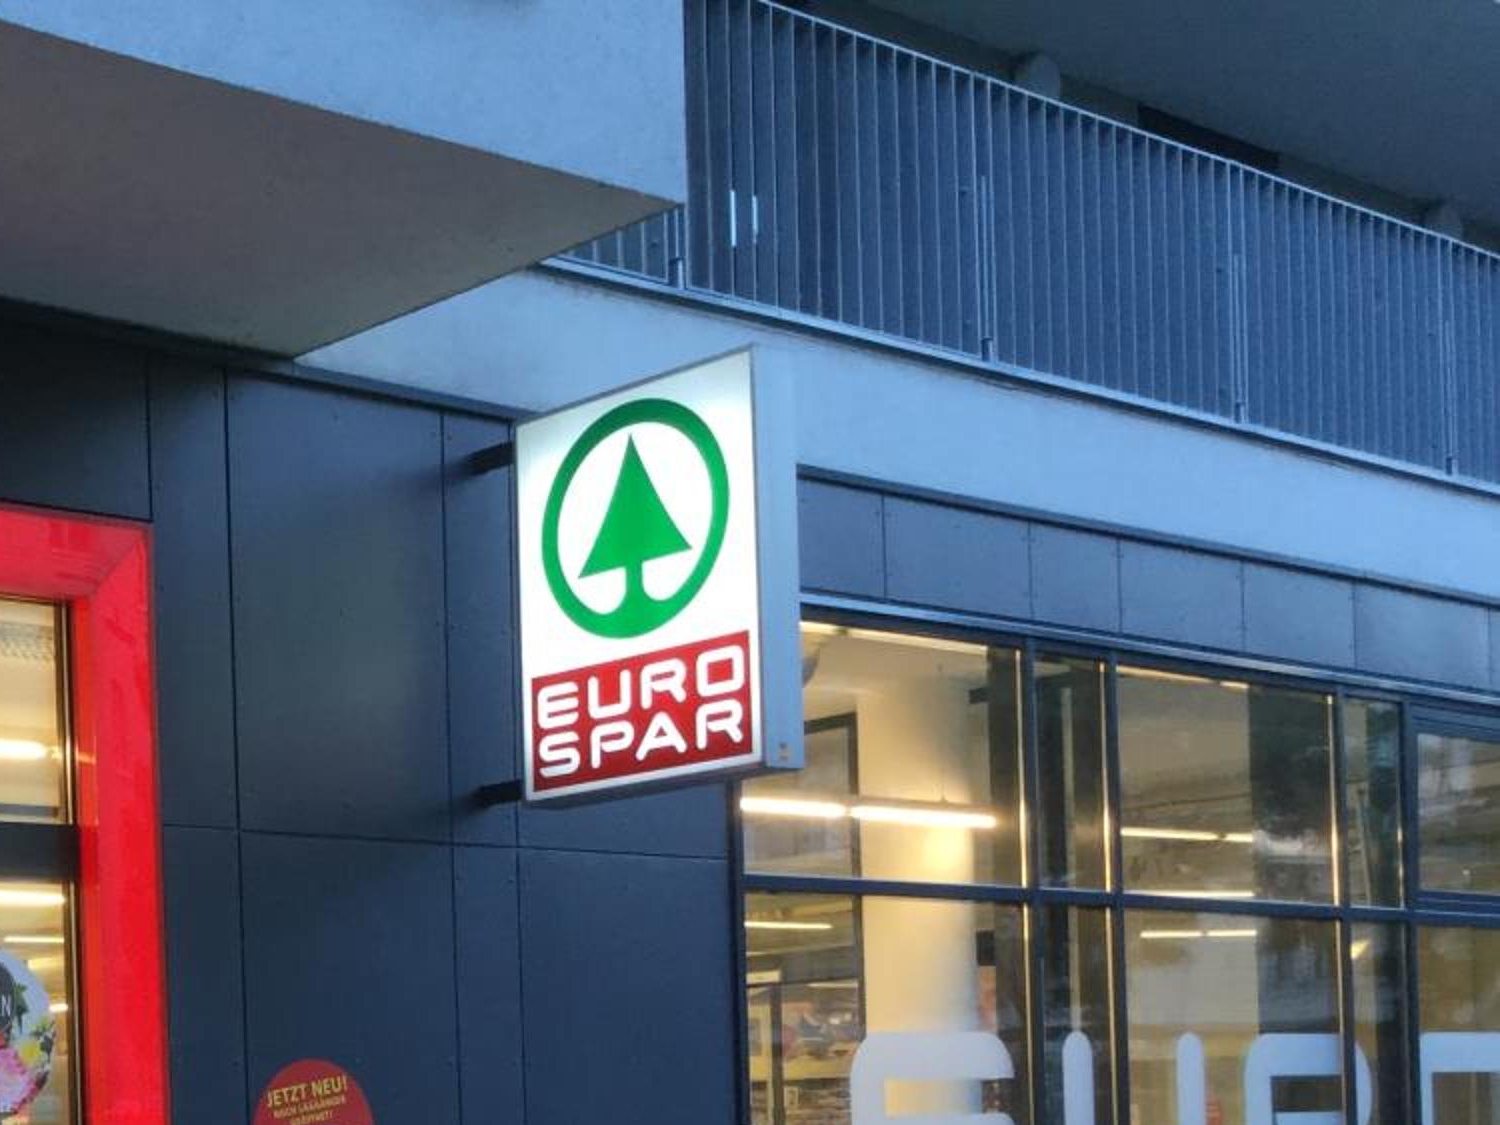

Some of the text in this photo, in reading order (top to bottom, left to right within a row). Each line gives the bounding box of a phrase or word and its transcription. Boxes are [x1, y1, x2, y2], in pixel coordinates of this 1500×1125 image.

[537, 644, 745, 730] EURO
[538, 698, 744, 778] SPAR
[266, 1074, 348, 1109] JETZT NEU!
